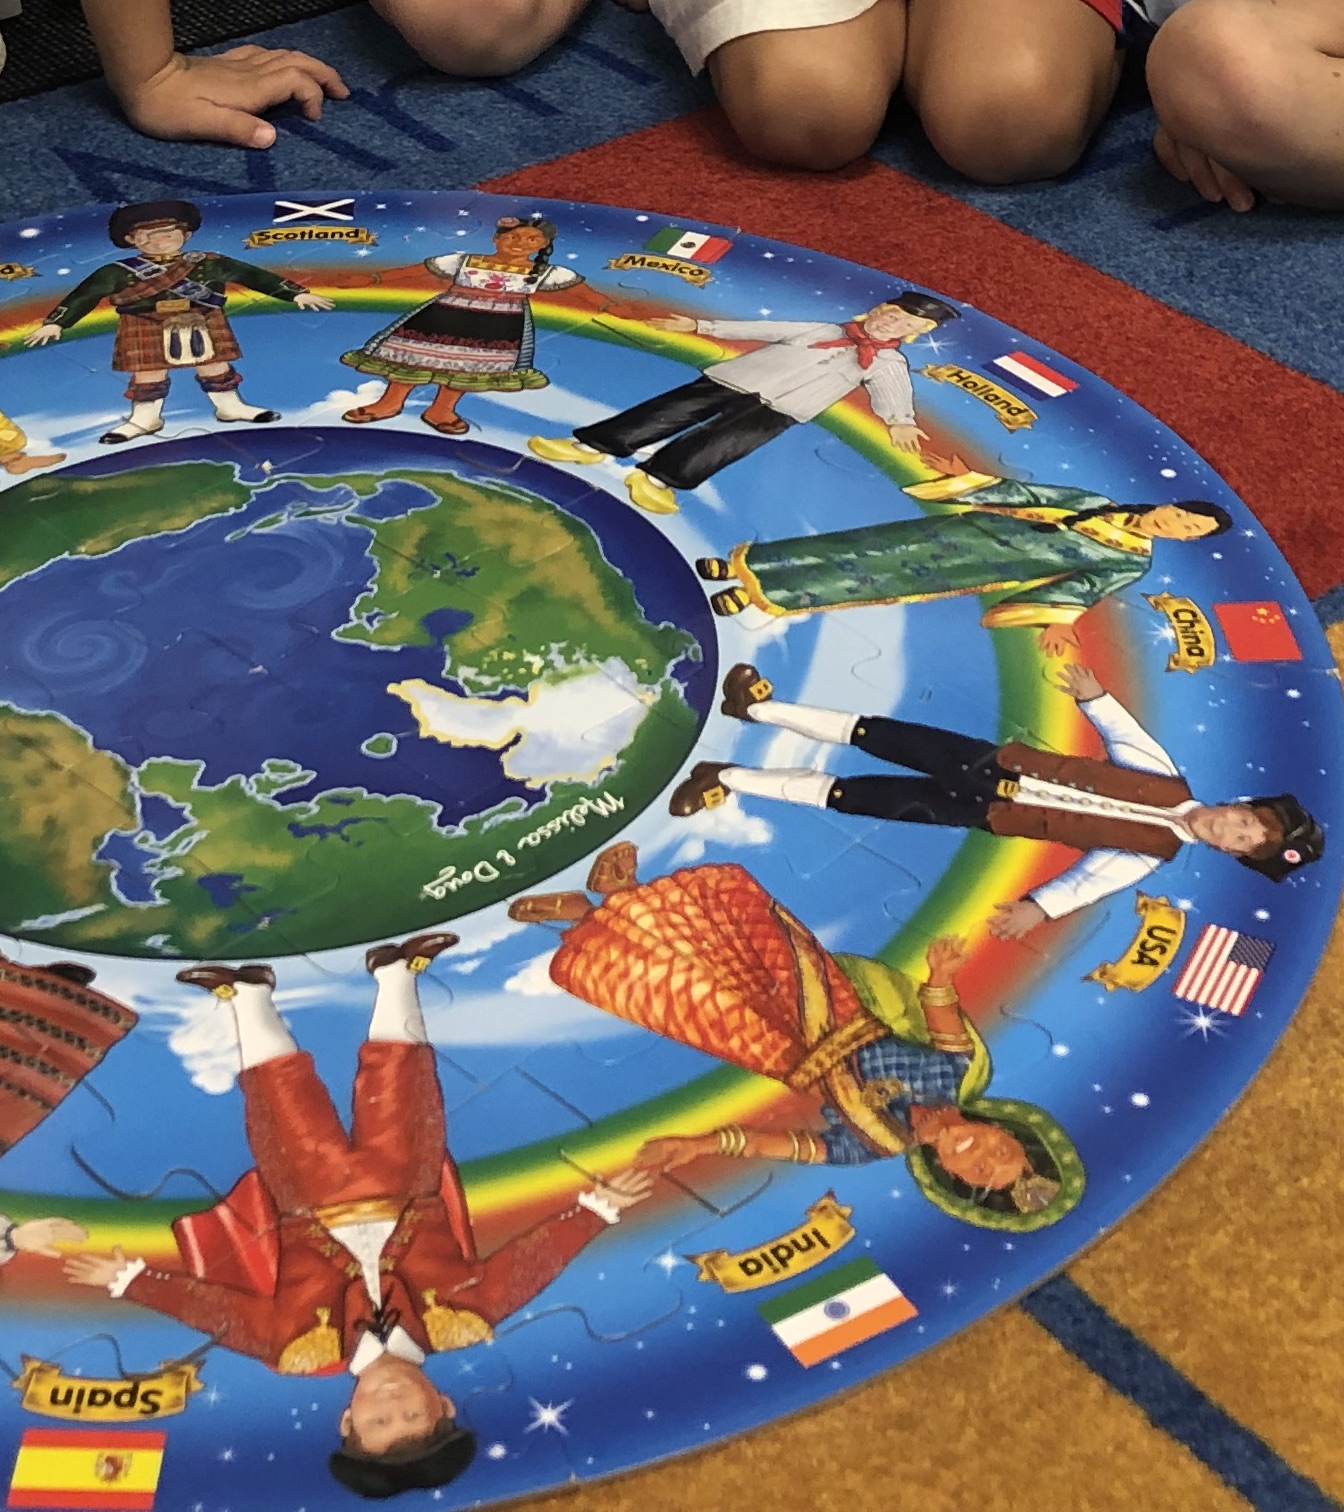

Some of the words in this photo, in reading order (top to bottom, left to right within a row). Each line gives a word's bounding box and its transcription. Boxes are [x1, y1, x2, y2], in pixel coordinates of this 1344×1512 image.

[256, 227, 360, 242] Scotland
[622, 254, 705, 277] Mexico
[946, 368, 1029, 417] Holland
[1172, 608, 1206, 658] China
[516, 790, 625, 851] Melissa
[419, 860, 501, 900] Doug
[1135, 924, 1177, 967] USA
[737, 1226, 832, 1275] India
[48, 1378, 165, 1416] Spain
